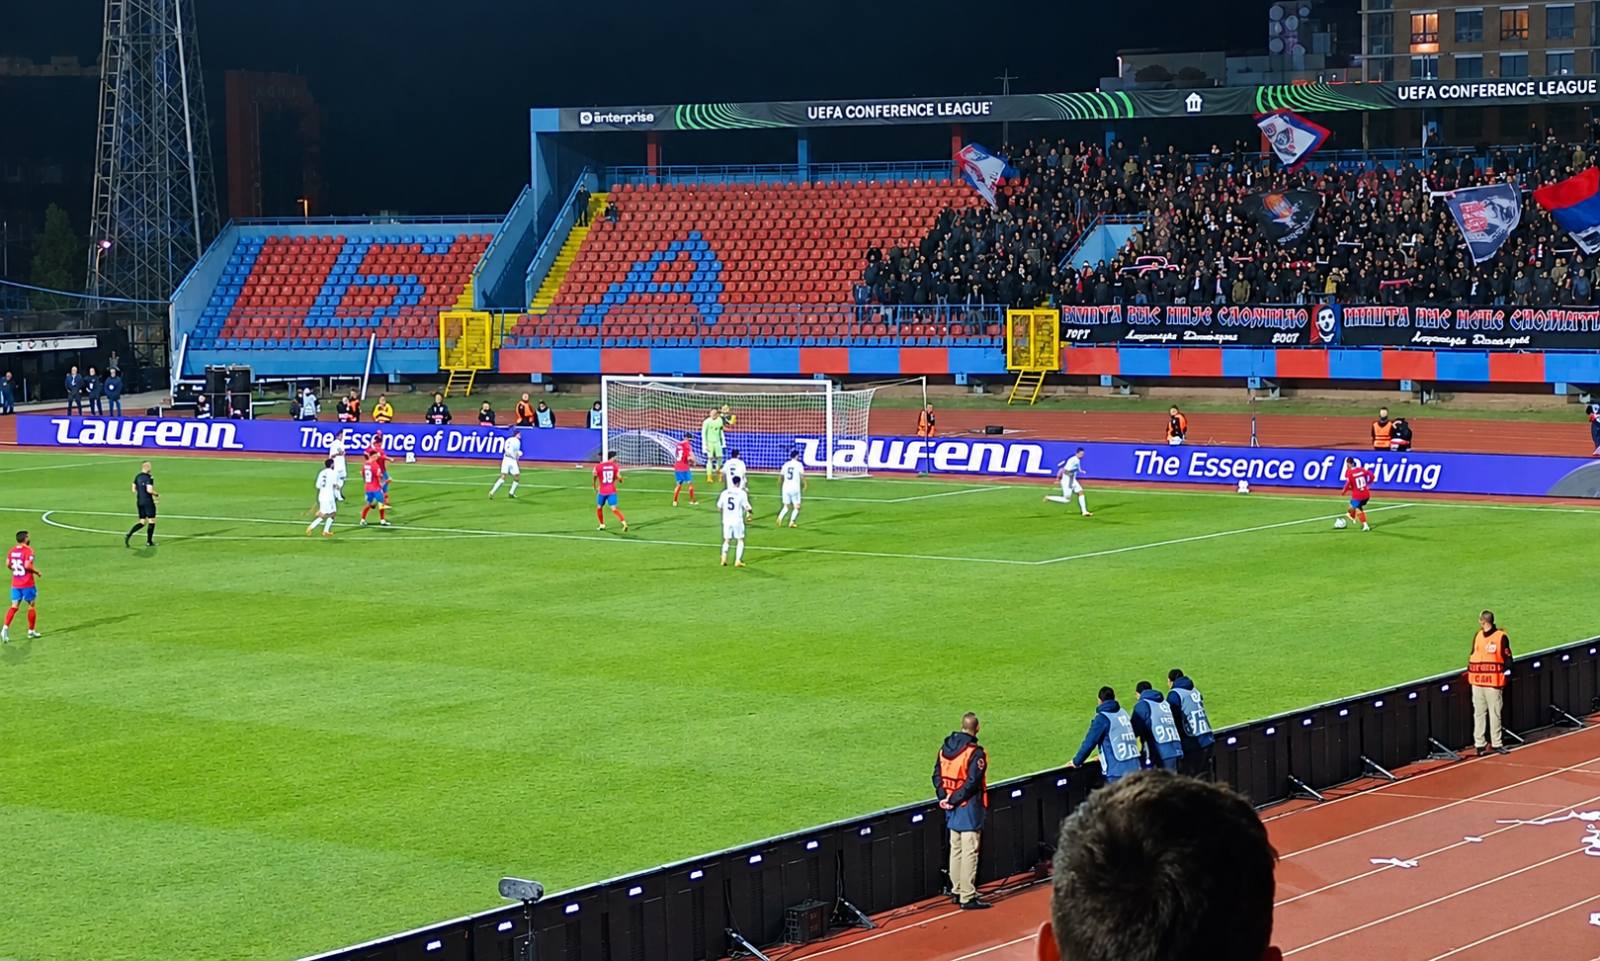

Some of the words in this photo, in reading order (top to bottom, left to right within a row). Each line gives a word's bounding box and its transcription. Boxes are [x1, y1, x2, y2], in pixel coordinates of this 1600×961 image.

[1398, 85, 1436, 100] UEFA
[1439, 82, 1535, 99] CONFERENCE
[1539, 79, 1597, 95] LEAGUE
[807, 106, 843, 119] UEFA
[845, 103, 934, 119] CONFERENCE
[938, 102, 990, 116] LEAGUE
[300, 427, 334, 448] The
[342, 430, 415, 452] Essnce
[421, 432, 444, 453] of
[1134, 450, 1180, 476] The
[1188, 452, 1300, 480] Essence
[1303, 455, 1335, 481] of
[727, 497, 735, 510] 5
